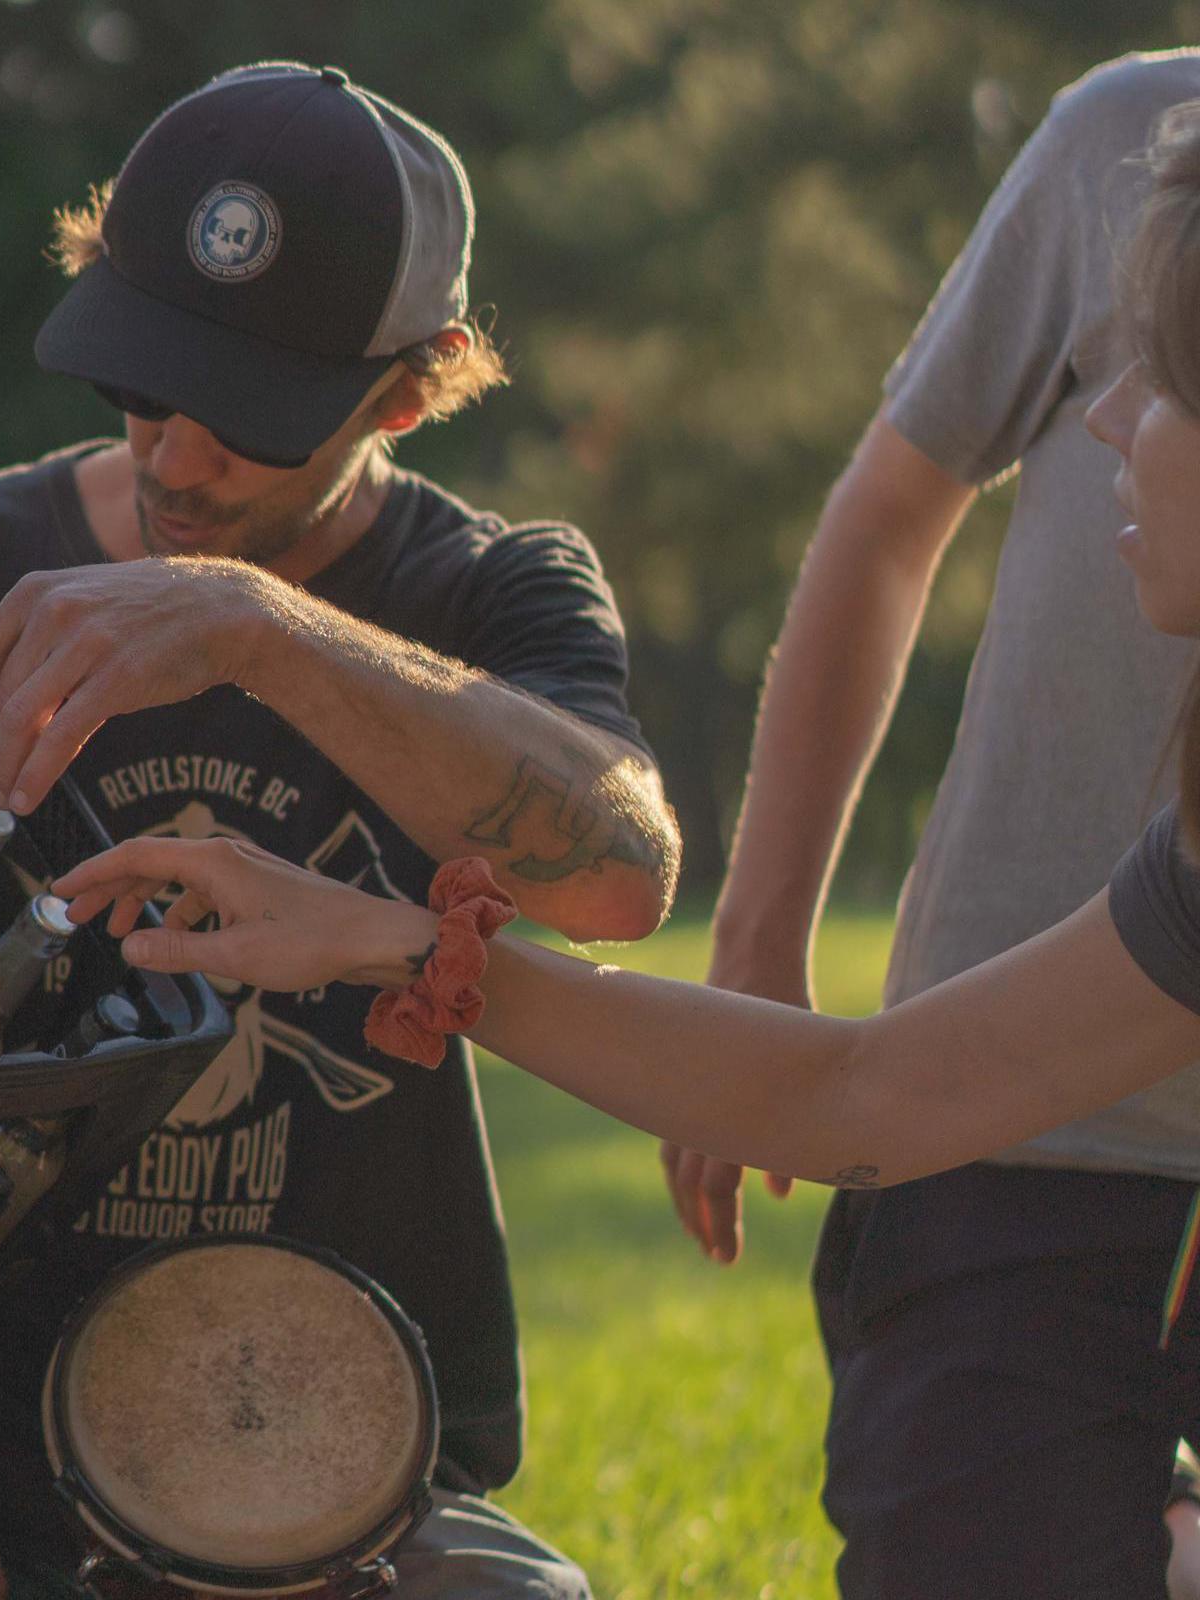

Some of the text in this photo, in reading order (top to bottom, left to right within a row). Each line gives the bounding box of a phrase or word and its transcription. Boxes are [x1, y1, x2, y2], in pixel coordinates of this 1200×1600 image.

[99, 755, 300, 821] REVELSTOKE, BC
[137, 1100, 291, 1203] EDDY PUB
[96, 1196, 189, 1239] LIQUOR
